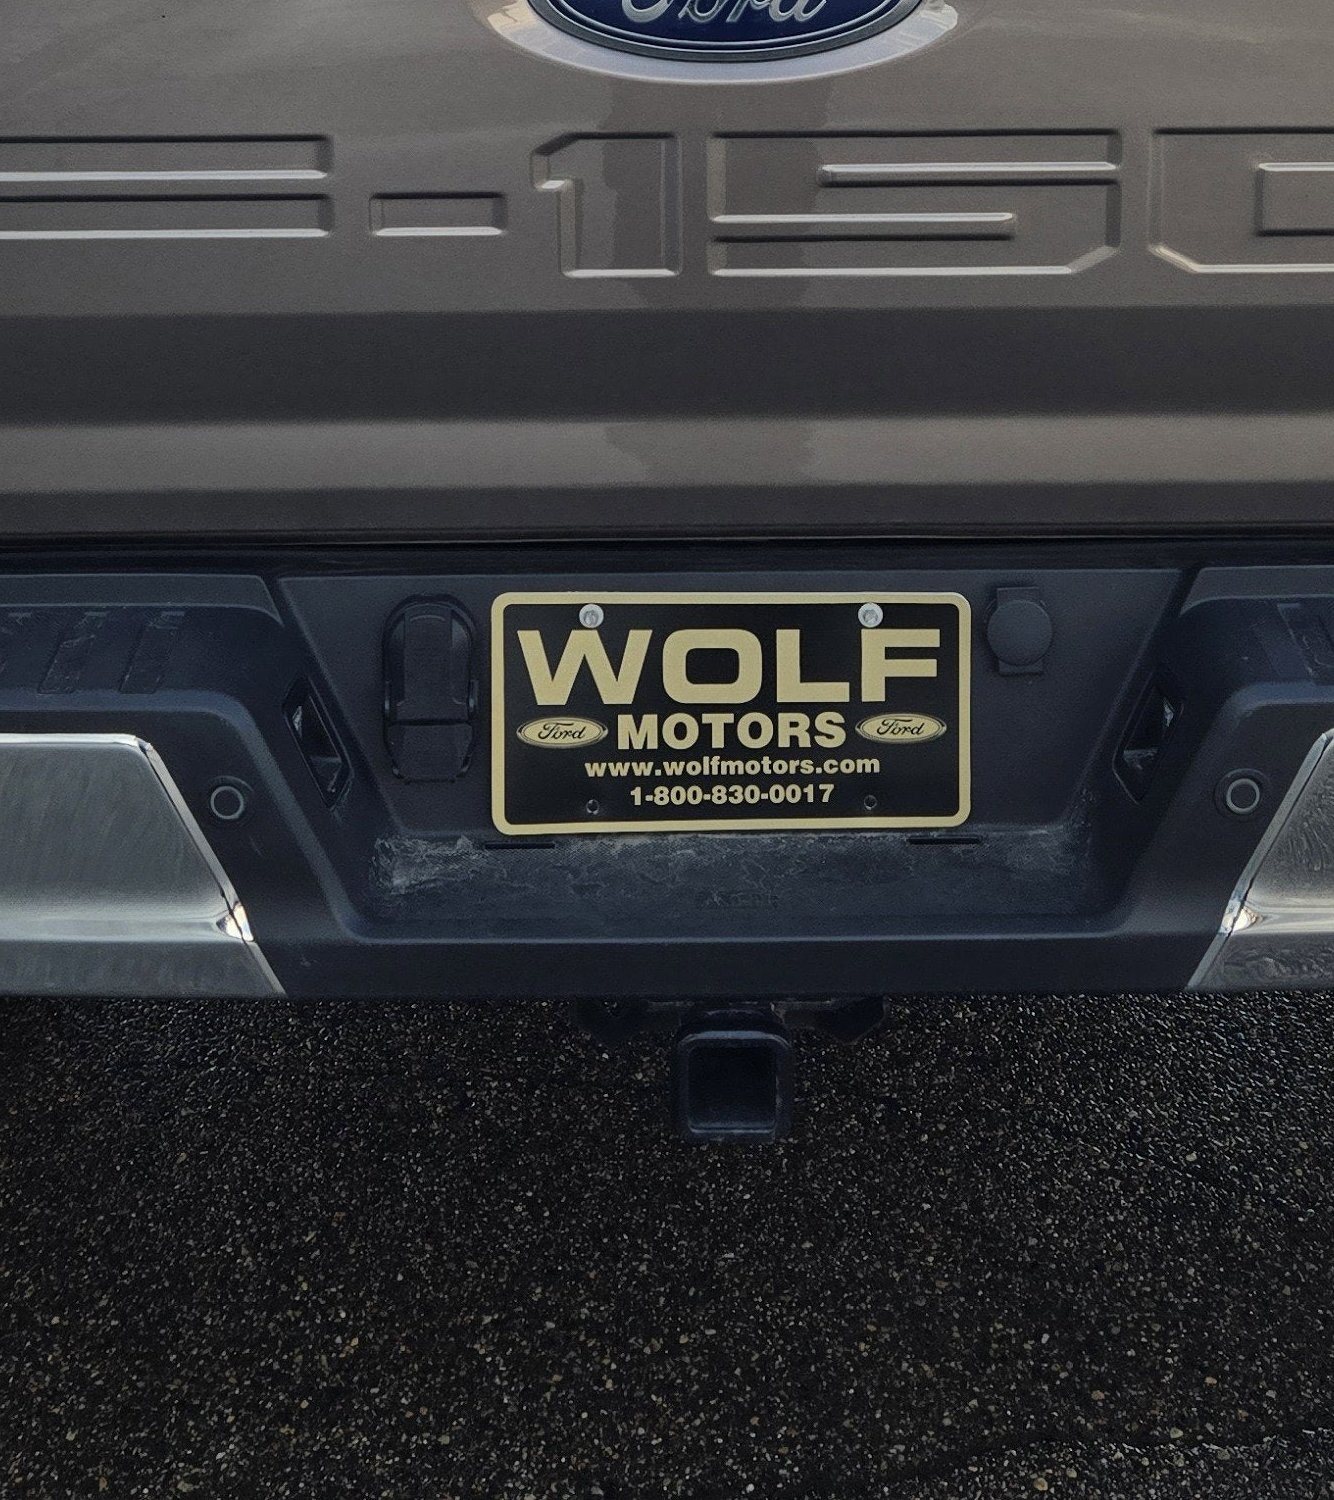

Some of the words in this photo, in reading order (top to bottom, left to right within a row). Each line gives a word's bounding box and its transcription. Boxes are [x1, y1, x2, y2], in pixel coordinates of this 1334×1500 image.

[516, 628, 942, 706] WOLF
[536, 721, 586, 742] Ford
[617, 711, 847, 750] MOTORS
[875, 718, 926, 738] Ford
[584, 755, 881, 778] www.wolfmotors.com
[630, 784, 835, 806] 1-800-830-0017
